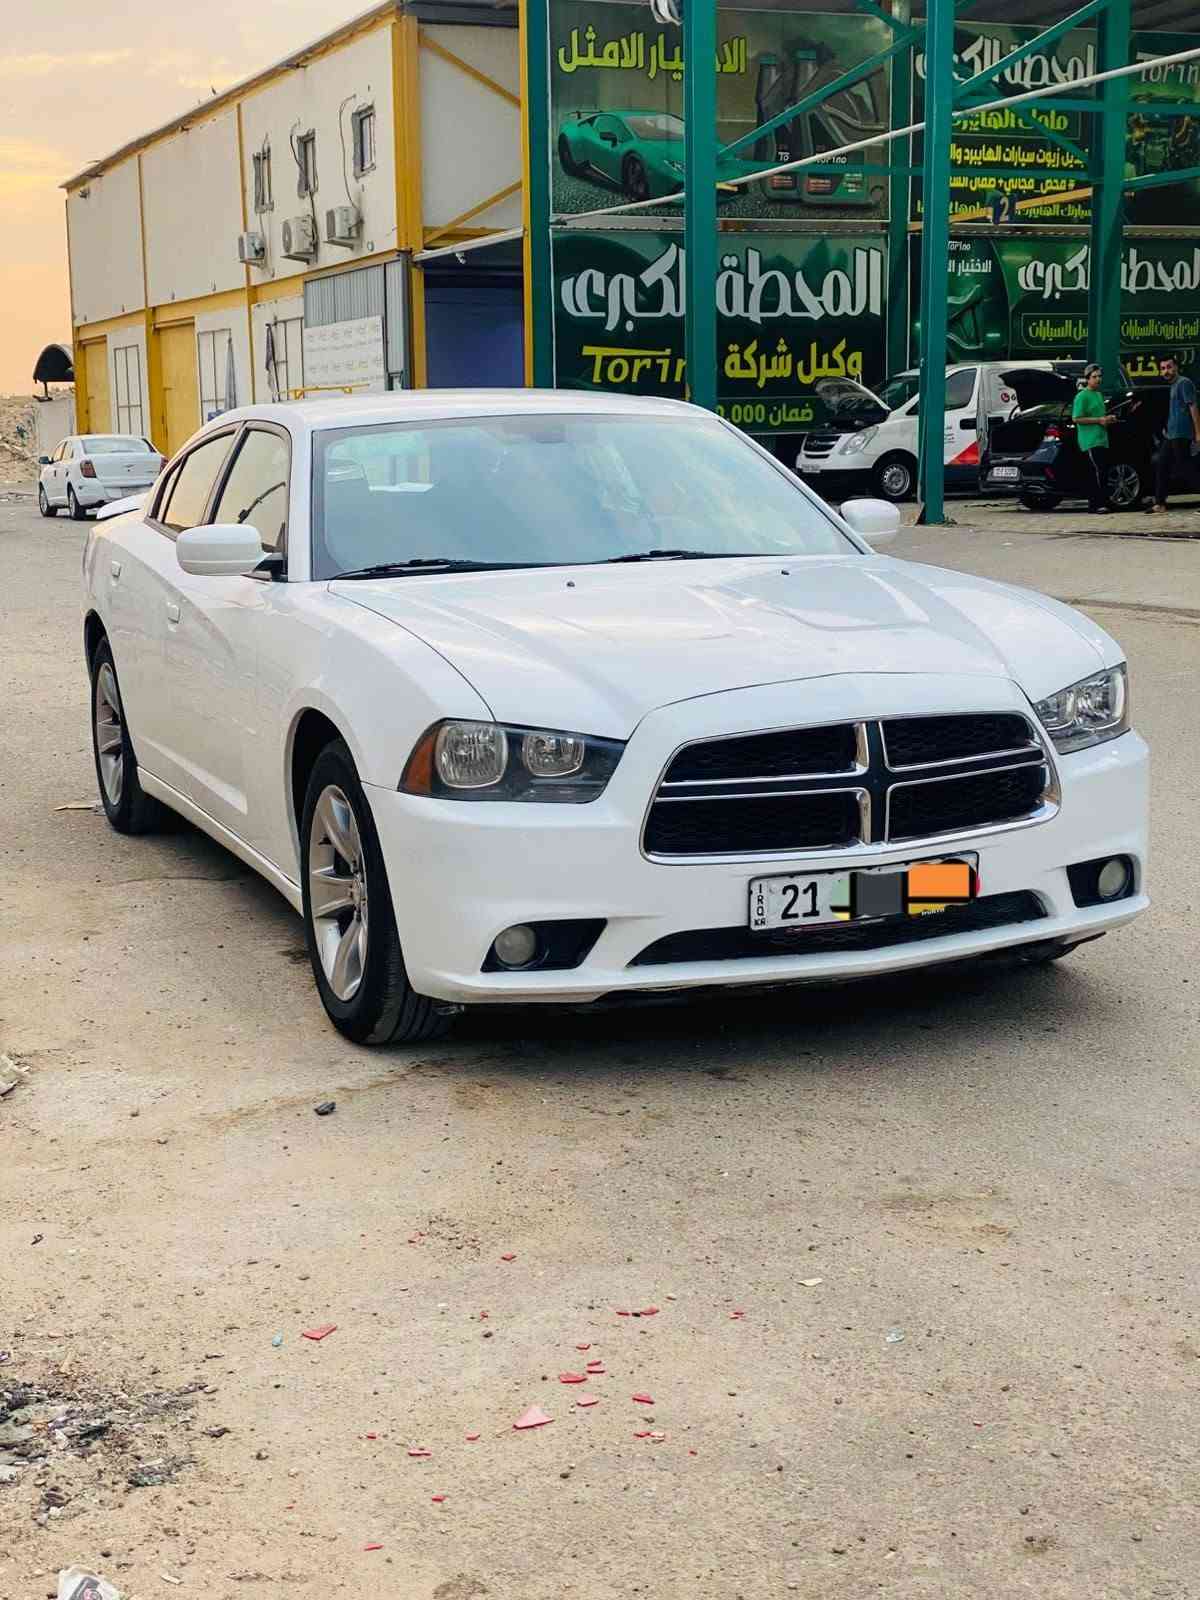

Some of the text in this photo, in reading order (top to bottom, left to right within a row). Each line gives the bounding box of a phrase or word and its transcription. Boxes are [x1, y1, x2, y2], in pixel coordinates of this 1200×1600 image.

[1136, 52, 1200, 83] Torin
[958, 258, 992, 276] الاختيار
[561, 242, 882, 332] المحطة لكبرى
[725, 337, 864, 389] وكيل شركة
[769, 402, 814, 426] ضمان
[781, 882, 820, 920] 21
